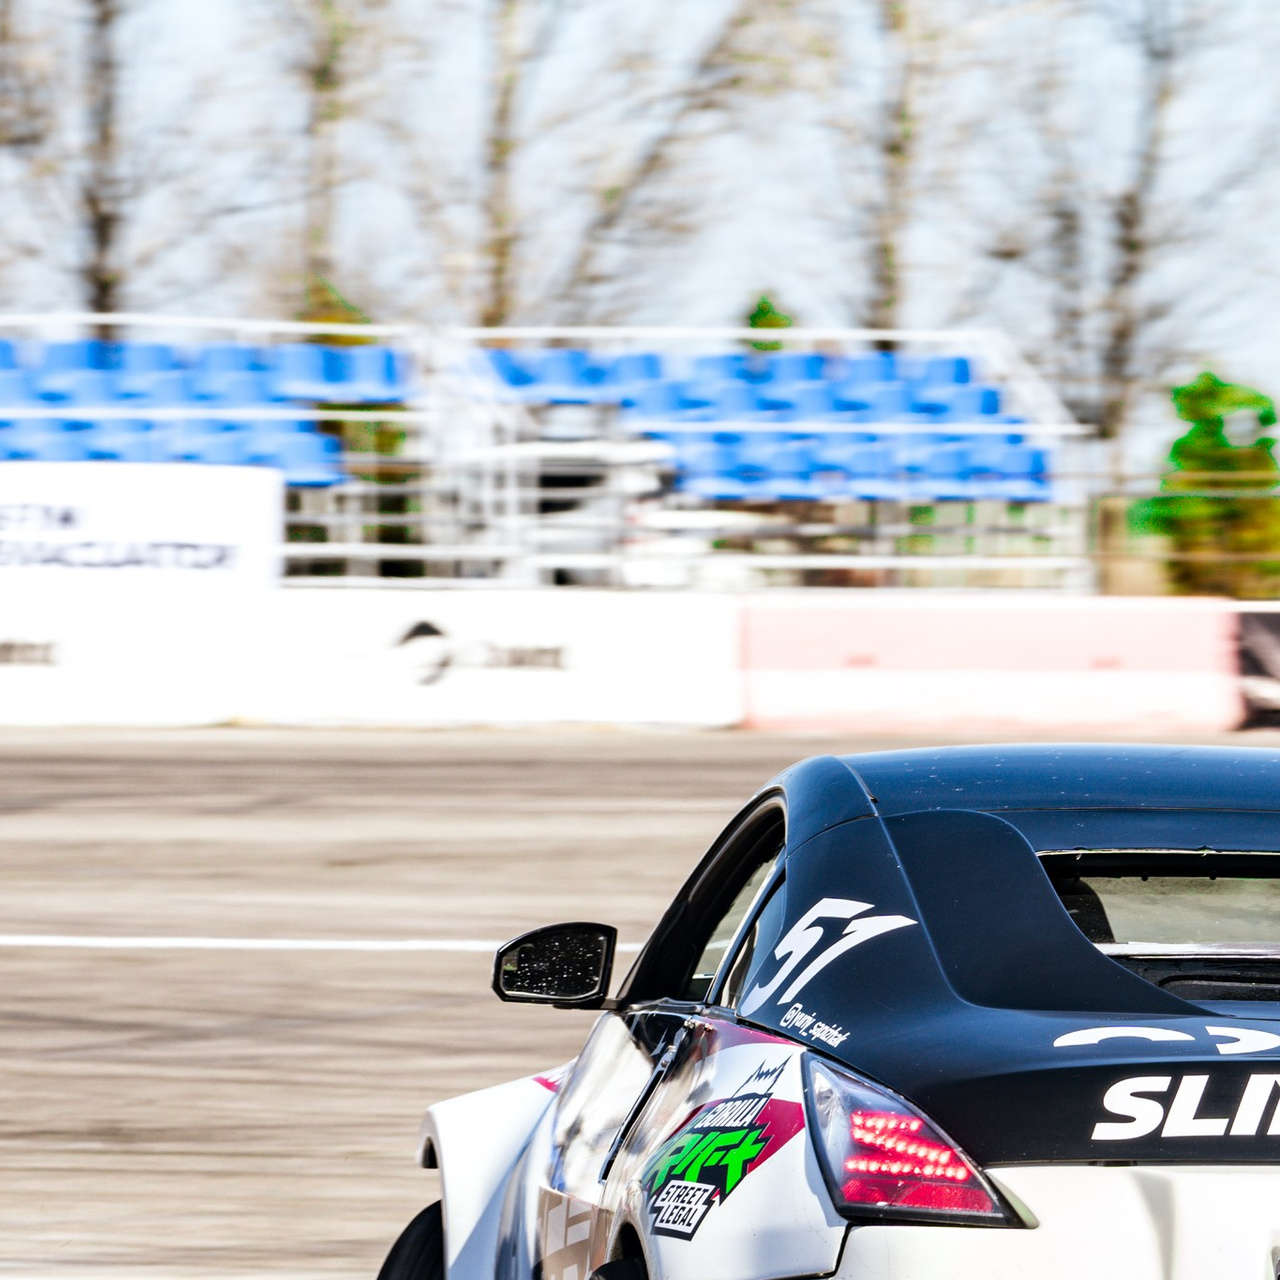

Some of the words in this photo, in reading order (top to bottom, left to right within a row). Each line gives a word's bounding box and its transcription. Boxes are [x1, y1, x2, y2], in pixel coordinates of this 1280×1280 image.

[738, 897, 919, 1017] 57
[694, 1097, 768, 1129] GORILLA
[660, 1184, 709, 1206] STREET
[659, 1205, 699, 1227] LEGAL
